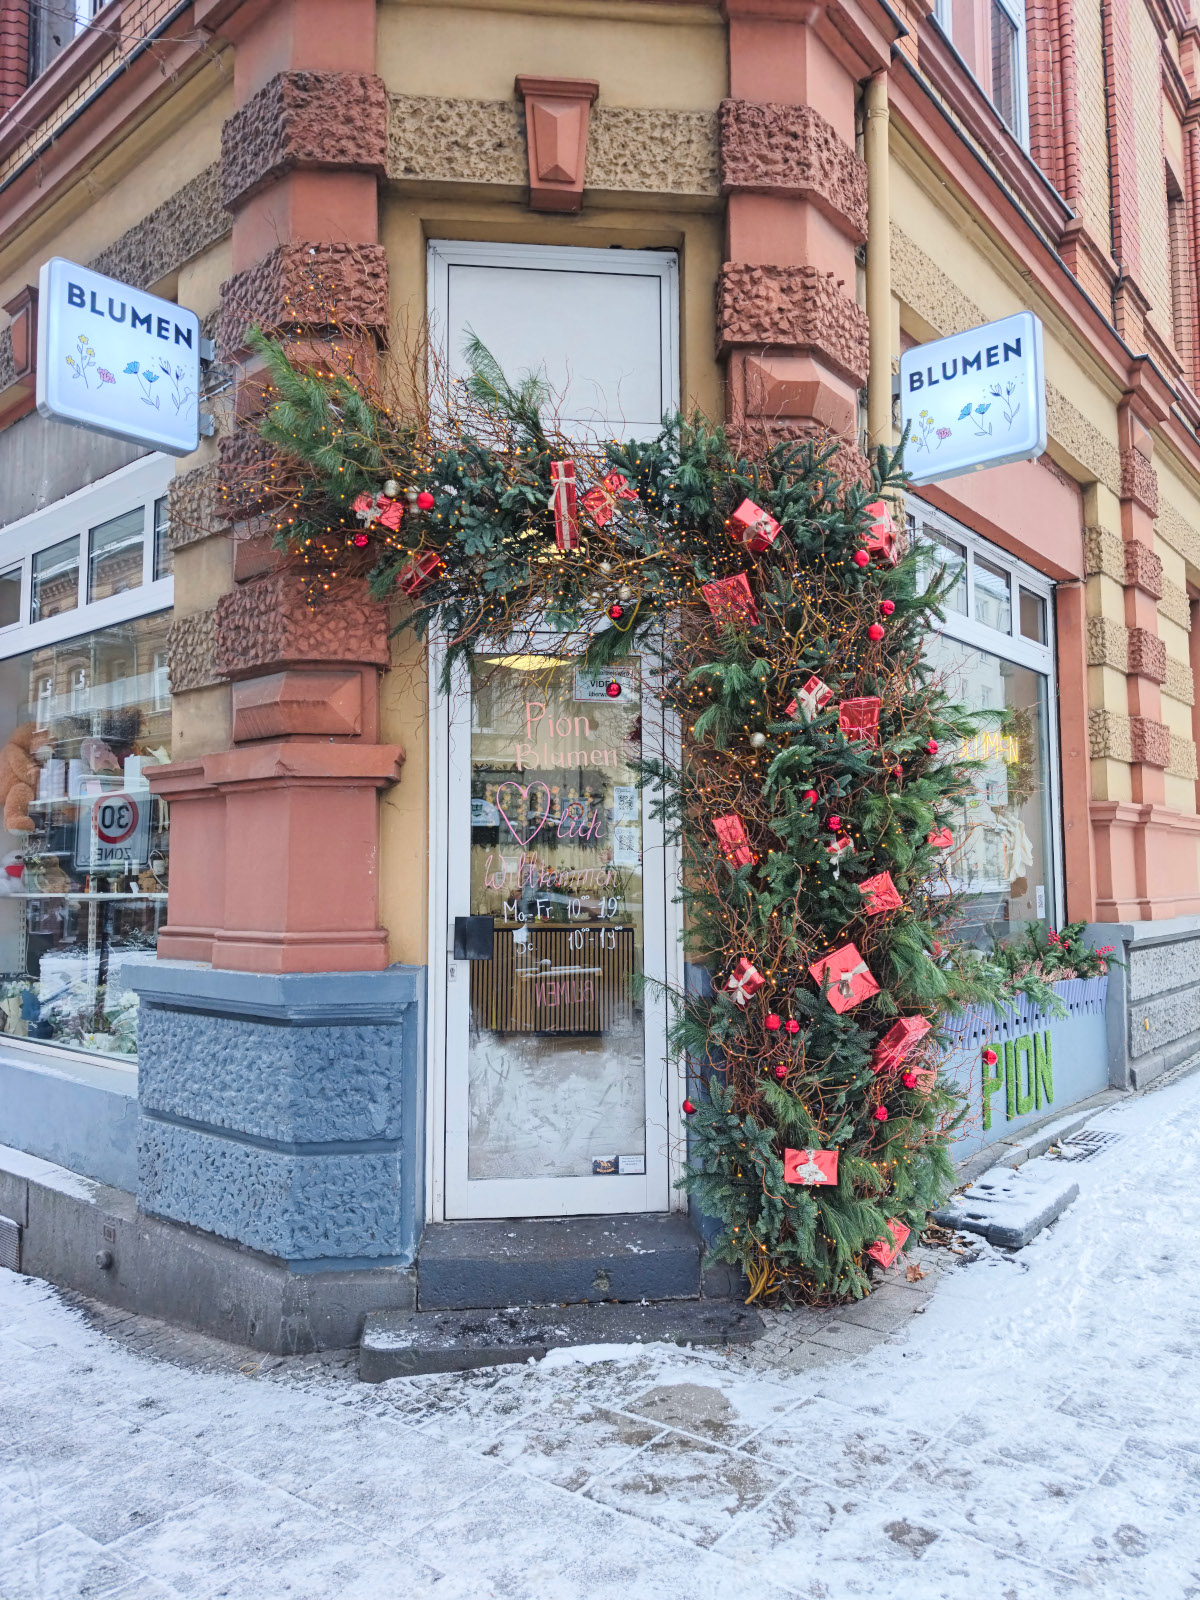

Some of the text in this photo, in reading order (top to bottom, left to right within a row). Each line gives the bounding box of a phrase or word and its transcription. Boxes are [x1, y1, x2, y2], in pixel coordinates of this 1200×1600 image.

[67, 281, 193, 350] BLUMEN
[909, 337, 1022, 393] BLUMEN
[525, 701, 590, 739] Pion
[515, 743, 618, 772] Blumen
[484, 850, 618, 890] Willkommen
[982, 1029, 1054, 1131] PION
